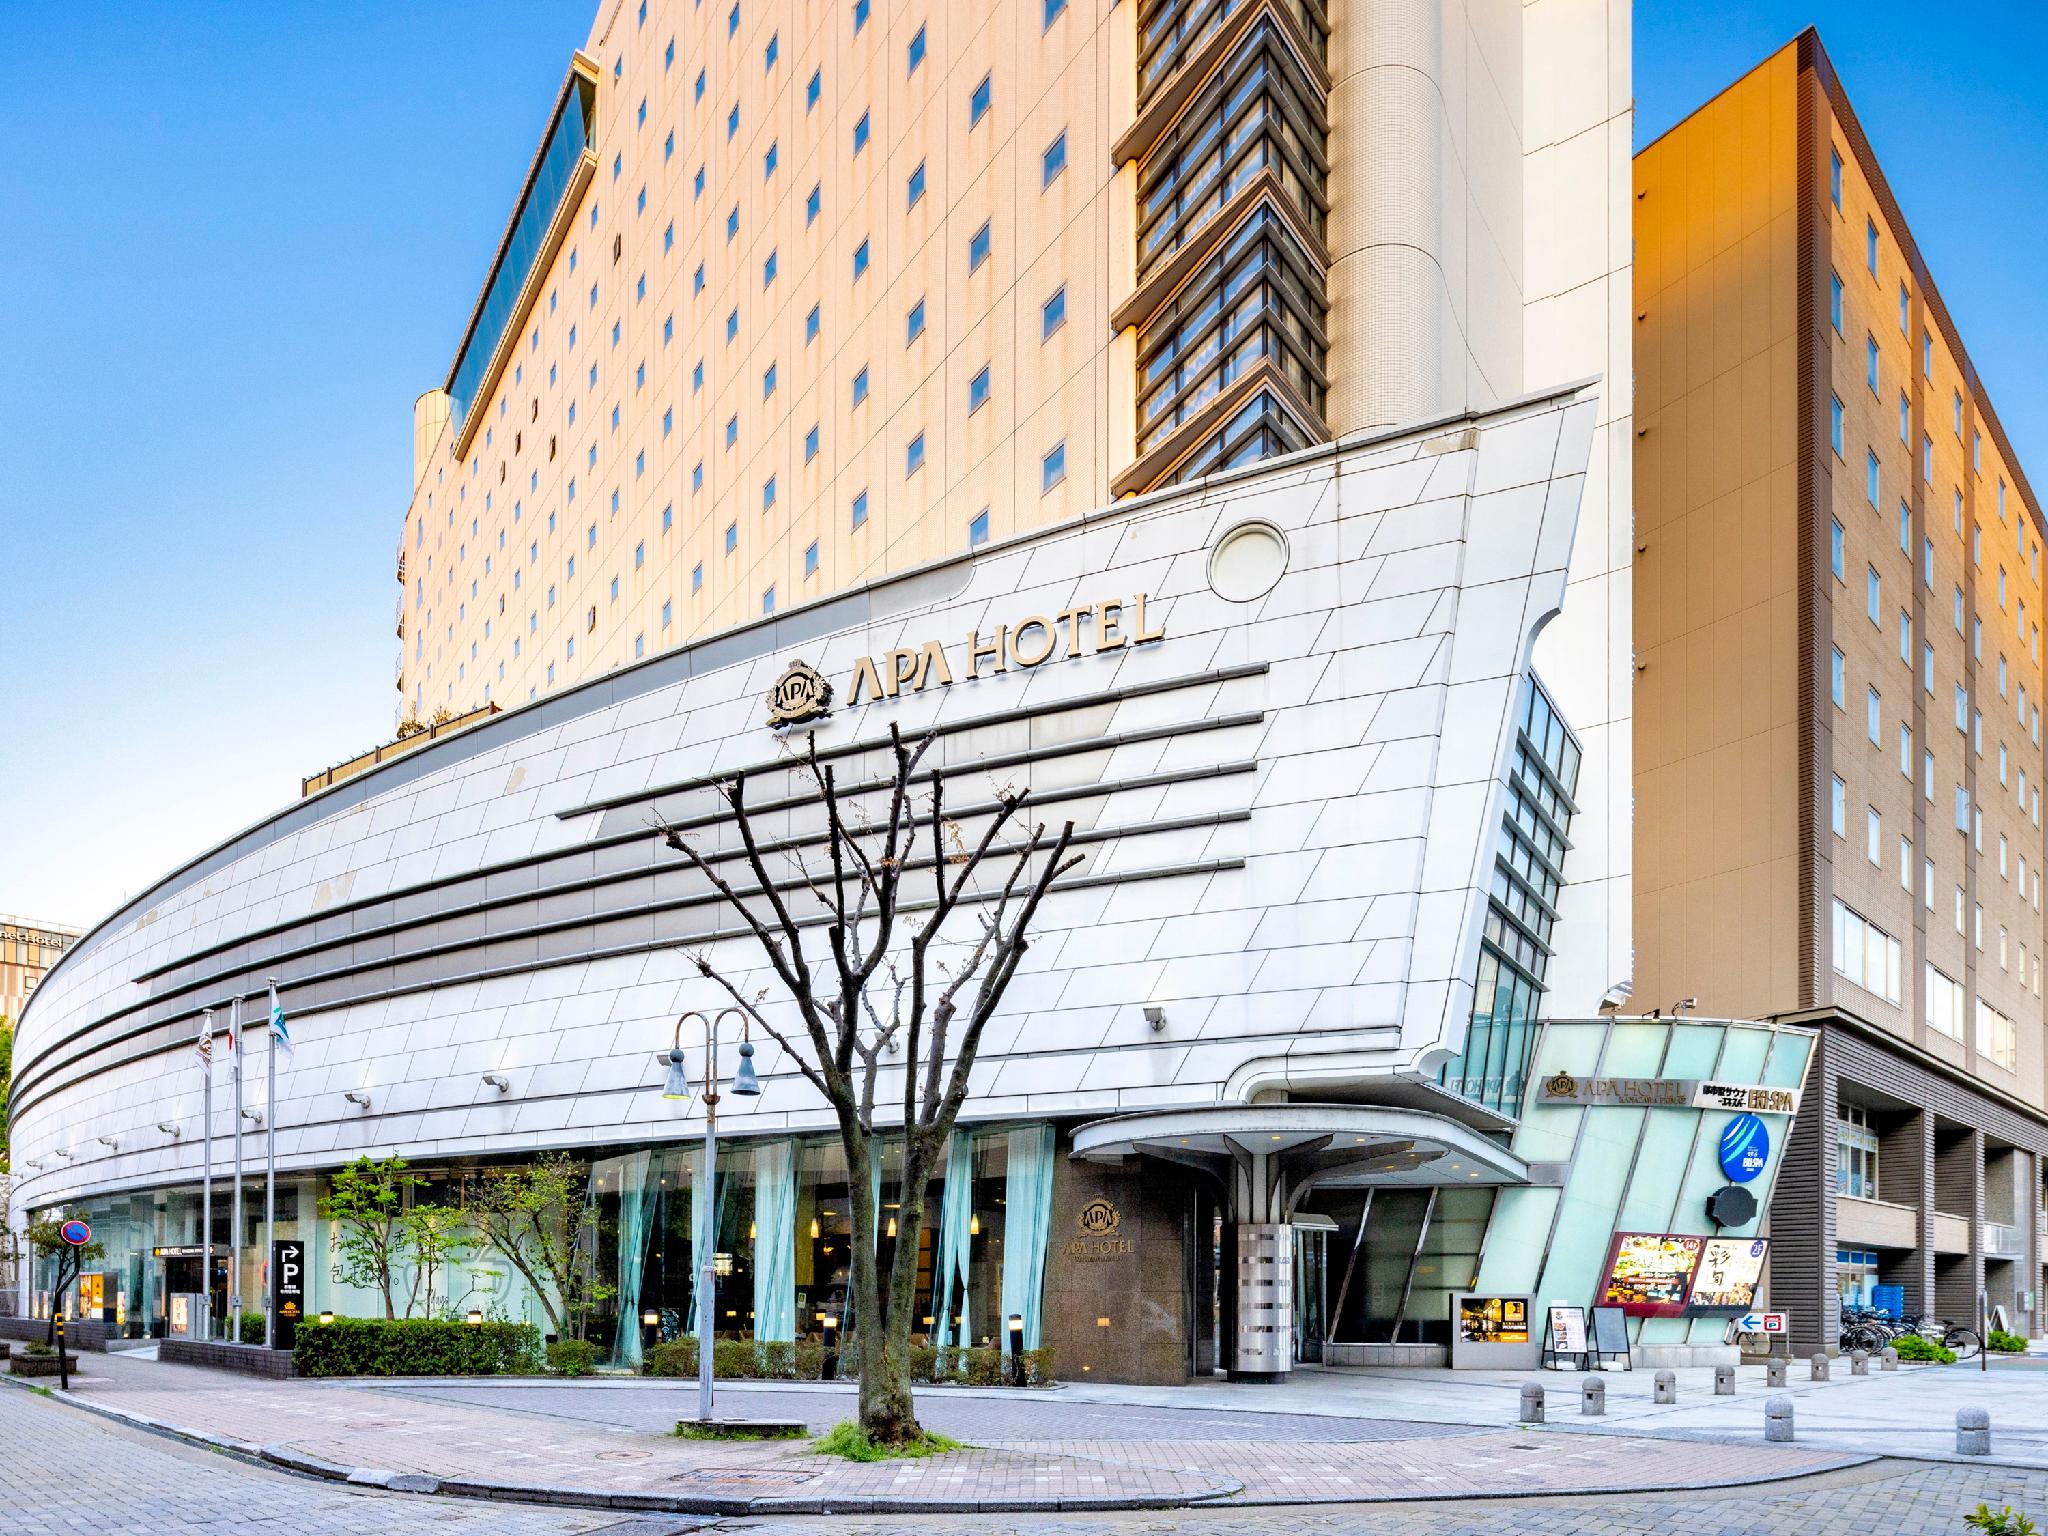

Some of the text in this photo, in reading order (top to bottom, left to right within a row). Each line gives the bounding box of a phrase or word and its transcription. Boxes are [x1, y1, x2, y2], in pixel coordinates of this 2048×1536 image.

[846, 592, 1166, 706] APA HOTEL
[777, 679, 814, 708] APA
[25, 931, 62, 947] Hotel
[1583, 1080, 1686, 1097] APA HOTEL
[1748, 1089, 1793, 1111] EKI-SPA
[1083, 1208, 1113, 1228] APA
[1063, 1239, 1135, 1255] APA HOTEL
[1752, 1244, 1763, 1255] 2F
[283, 1263, 299, 1284] P
